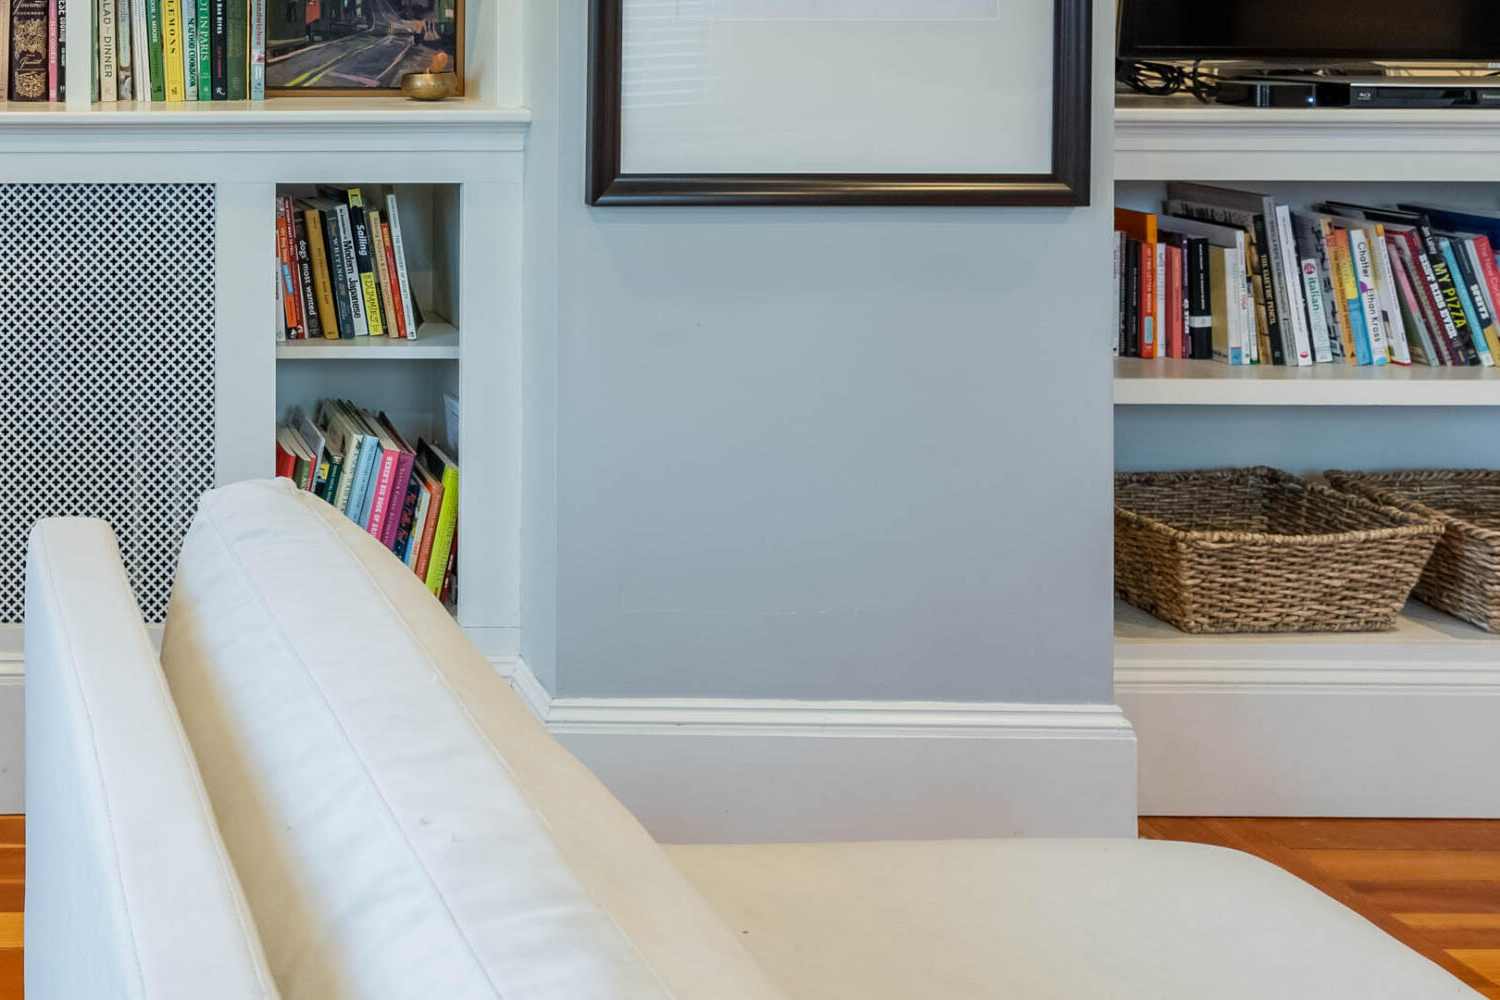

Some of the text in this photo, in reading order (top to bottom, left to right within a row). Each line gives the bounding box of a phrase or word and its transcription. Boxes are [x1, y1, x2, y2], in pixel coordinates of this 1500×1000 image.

[187, 18, 195, 49] SEAFOOD
[200, 31, 209, 61] PARIS
[104, 36, 112, 77] DINNER
[333, 238, 344, 281] WRITING
[356, 225, 368, 256] Sailing
[1358, 242, 1369, 278] Chatter
[343, 241, 362, 318] Modern Japanese
[1308, 277, 1320, 311] italian
[1432, 263, 1467, 328] MY PIZZA
[364, 280, 378, 322] DUMMIES
[1367, 288, 1380, 342] Ethan Kross
